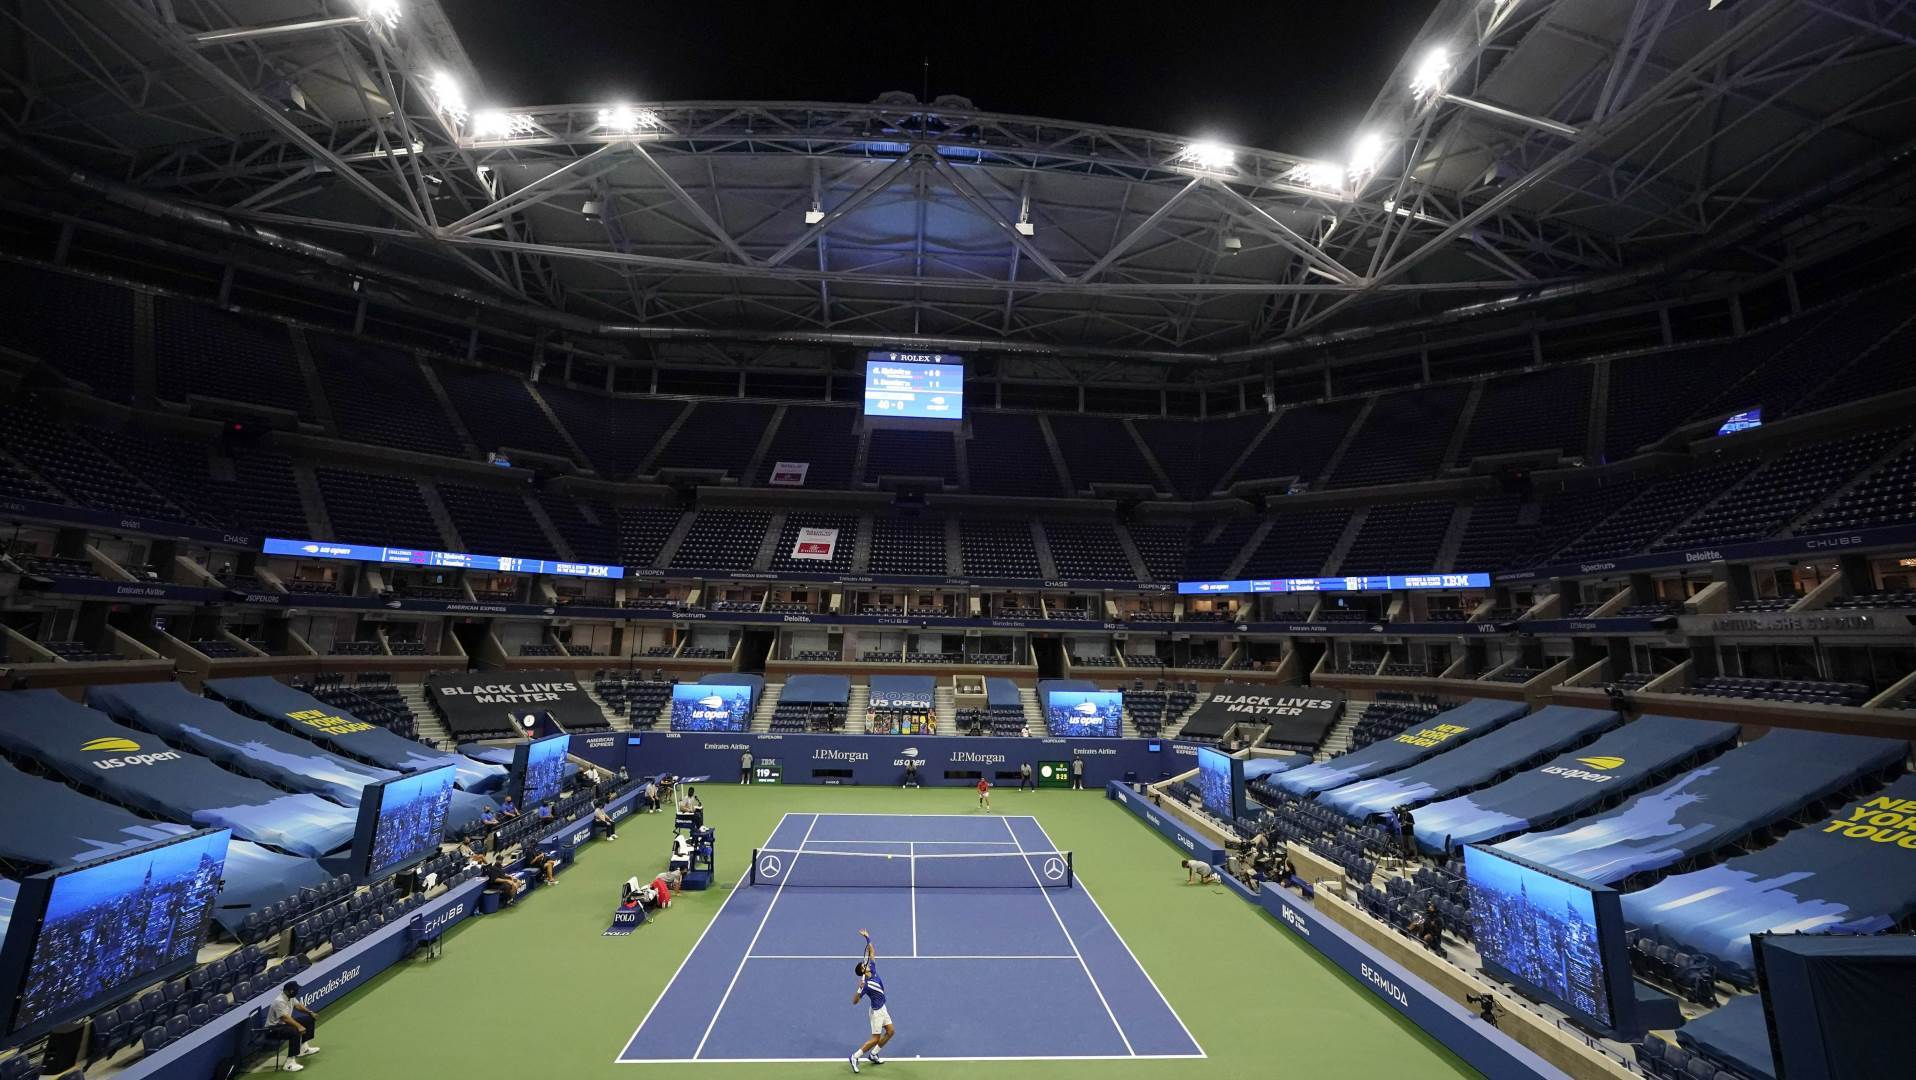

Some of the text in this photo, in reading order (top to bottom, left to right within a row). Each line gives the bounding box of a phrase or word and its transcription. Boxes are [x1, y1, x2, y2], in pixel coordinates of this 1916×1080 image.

[901, 354, 930, 362] ROLEX
[223, 534, 248, 545] CHASE
[1806, 536, 1862, 549] CHUBB
[588, 566, 608, 577] IBM
[1443, 575, 1469, 587] IBM
[672, 611, 703, 620] Spectrum
[1477, 624, 1495, 633] WTA
[440, 682, 577, 696] BLACK LIVES
[475, 692, 561, 704] MATTER
[871, 691, 932, 701] 2020
[1212, 694, 1334, 710] BLACK LIVES
[869, 699, 931, 708] US OPEN
[286, 709, 327, 721] NEW
[692, 710, 729, 720] us open
[1227, 703, 1303, 717] MATTER
[301, 716, 353, 728] YORK
[1069, 716, 1104, 726] us open
[318, 722, 377, 736] TOUGH
[1432, 723, 1470, 734] NEW
[1392, 734, 1441, 748] TOUGH
[1415, 729, 1456, 741] YORK
[92, 751, 182, 770] us open
[760, 758, 776, 766] IBM
[812, 749, 869, 763] J.P.Morgan
[950, 751, 1006, 765] J.P.Morgan
[756, 768, 770, 778] 119
[1541, 766, 1613, 783] us open
[1177, 833, 1195, 850] CHUBB
[425, 903, 464, 934] CHUBB
[614, 913, 635, 922] POLO
[1282, 904, 1295, 924] IHG
[299, 965, 361, 1008] Mercedes-Benz
[1361, 962, 1409, 1007] BERMUDA
